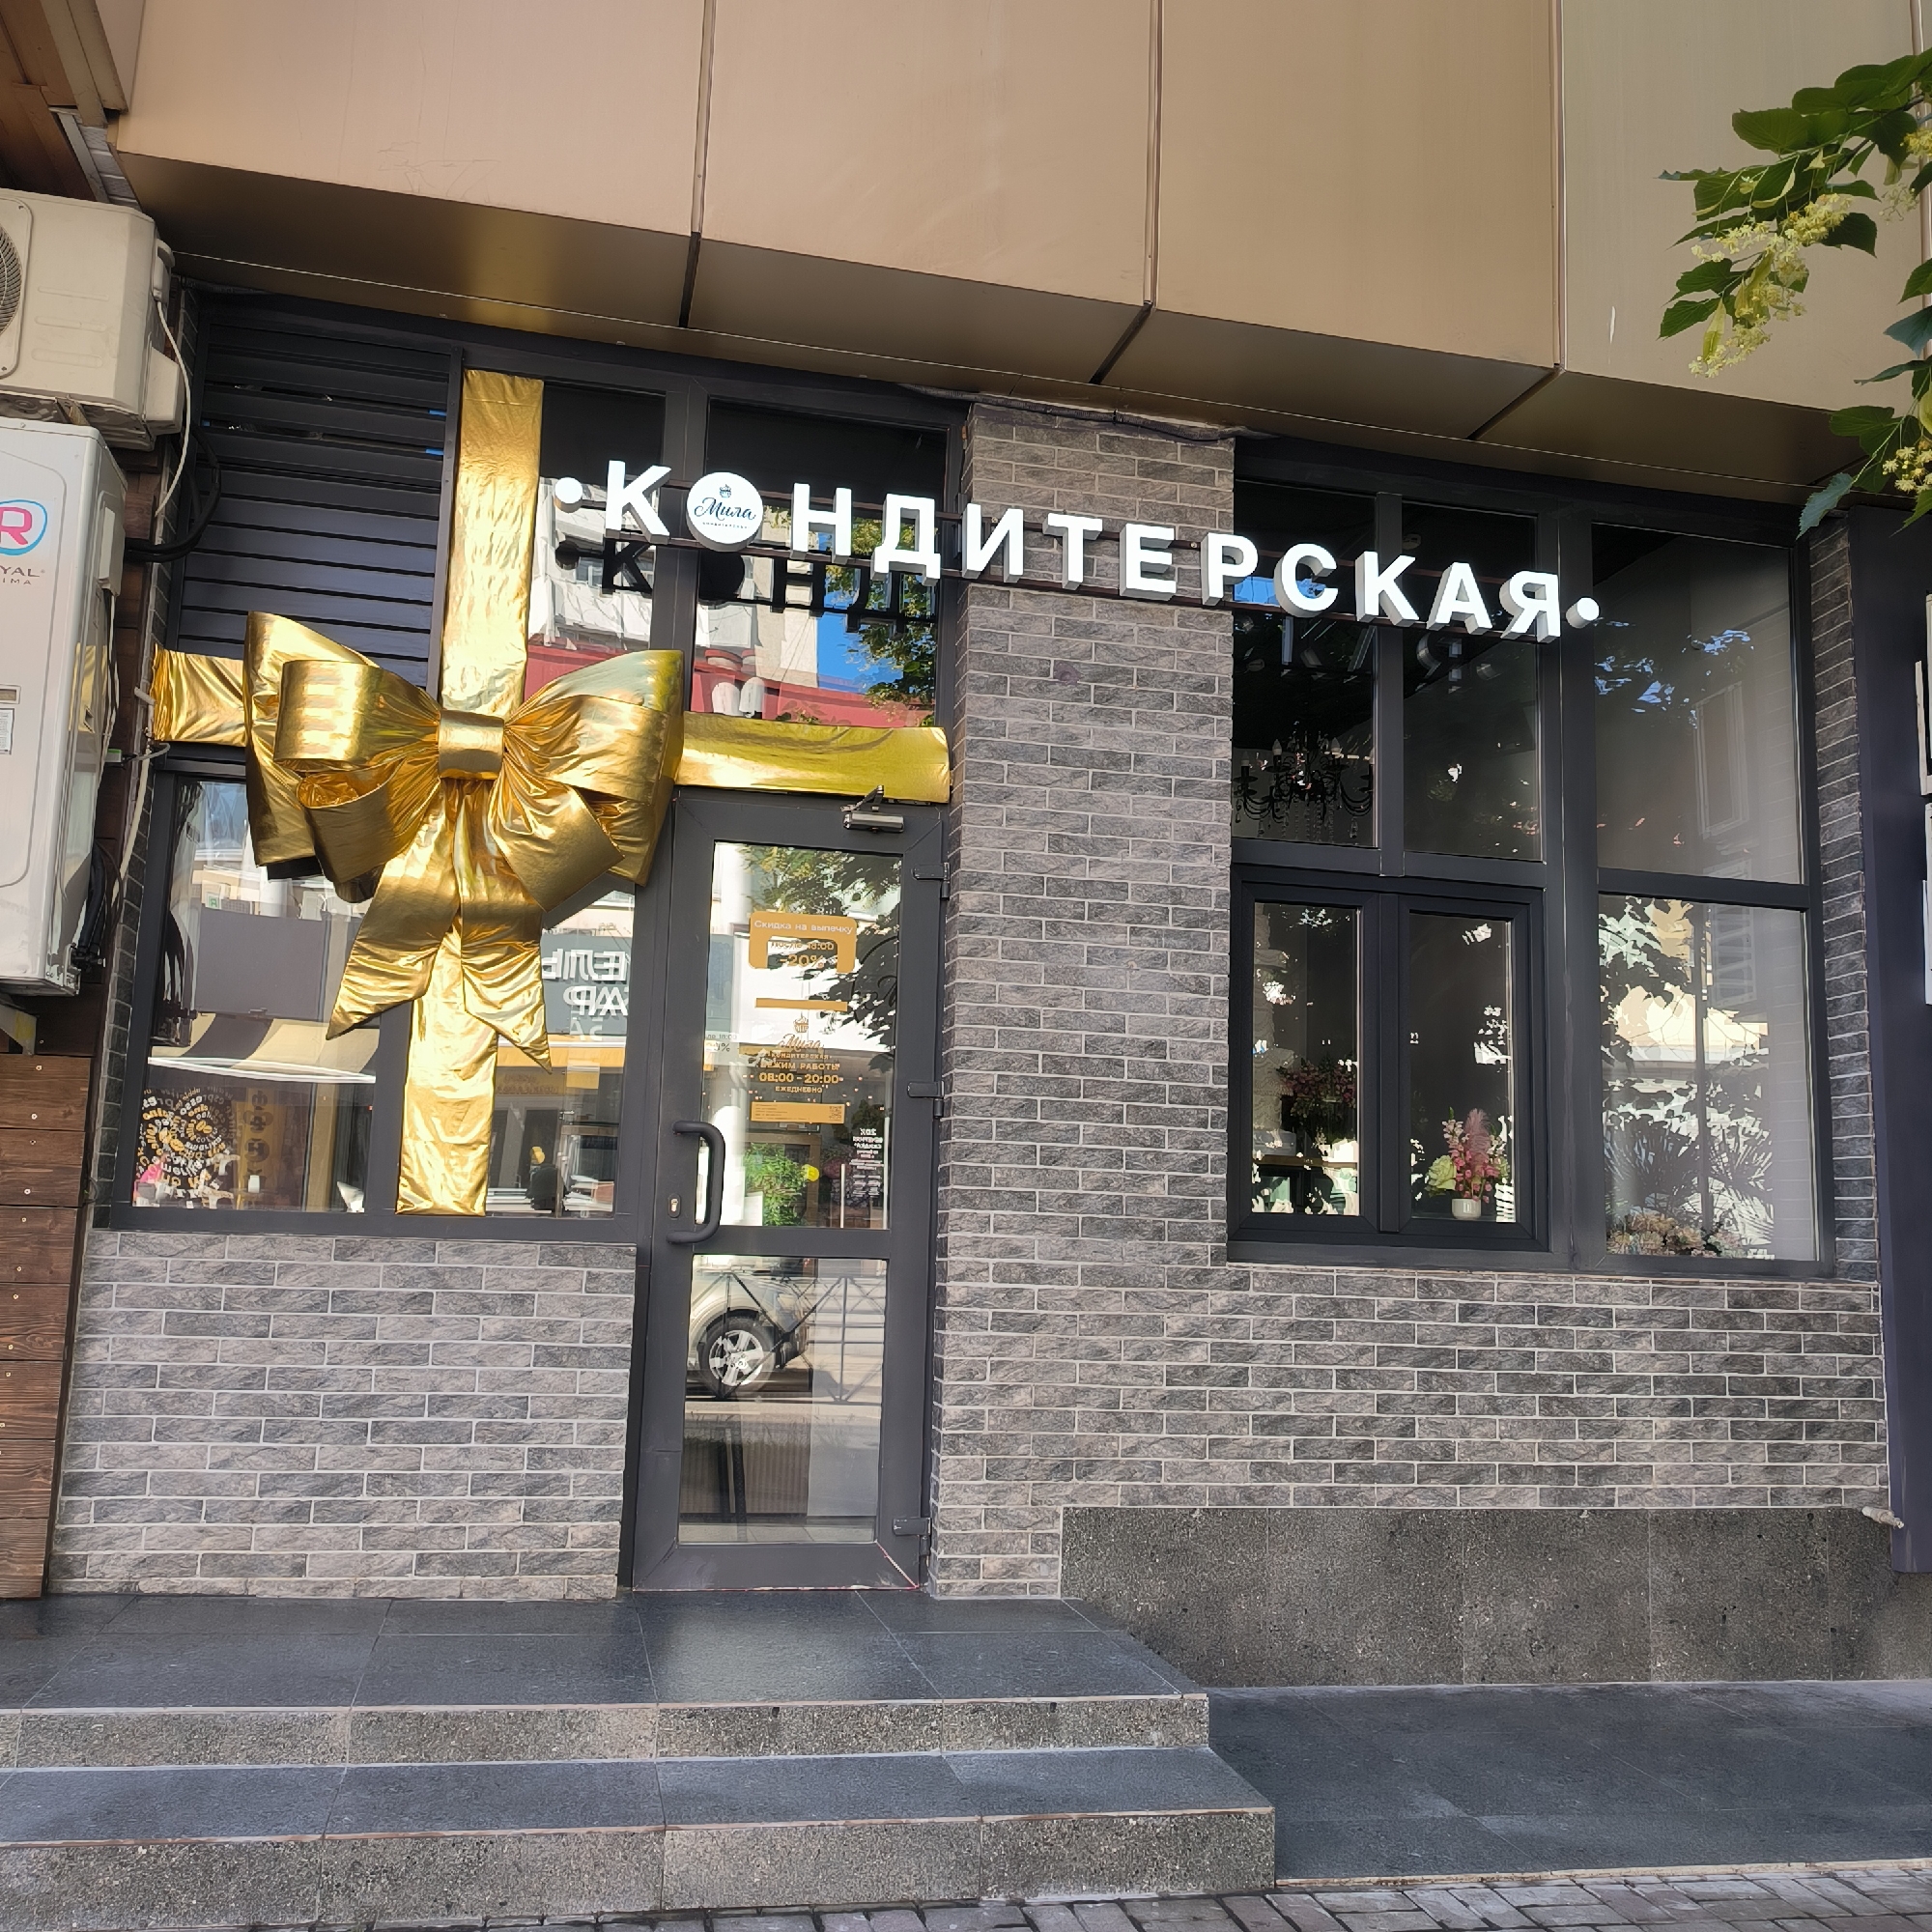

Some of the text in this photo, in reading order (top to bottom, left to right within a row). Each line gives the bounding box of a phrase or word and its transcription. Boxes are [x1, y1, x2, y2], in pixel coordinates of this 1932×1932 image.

[694, 497, 756, 522] Мила
[753, 920, 854, 935] Скидка на выпечку
[807, 942, 835, 951] 18:00
[780, 953, 825, 969] -20%
[800, 1063, 839, 1071] РАБОТЫ
[804, 1073, 839, 1084] 20:00
